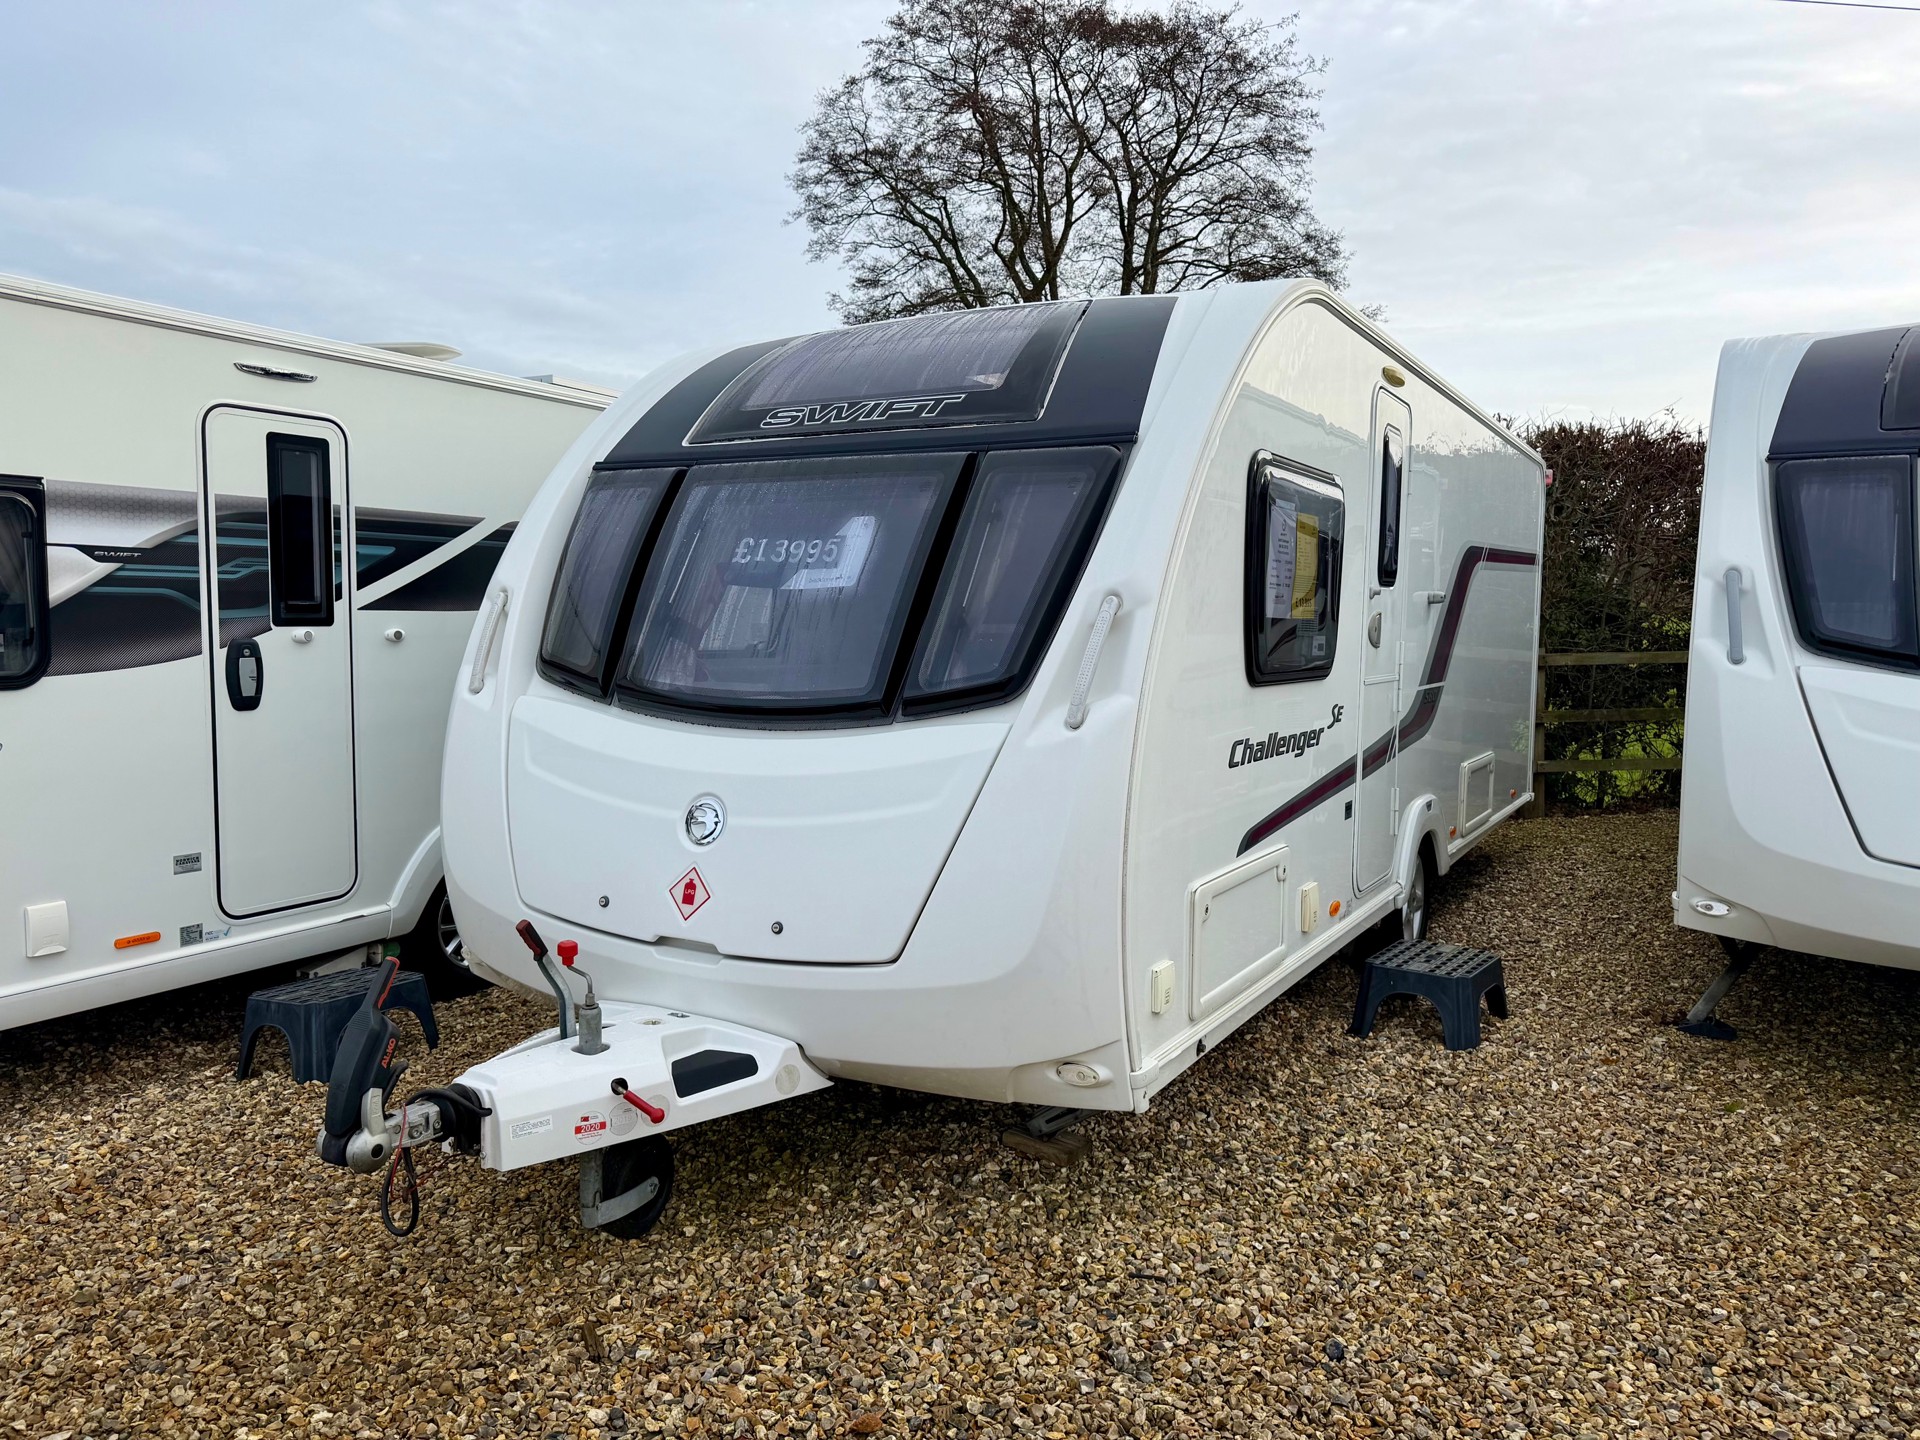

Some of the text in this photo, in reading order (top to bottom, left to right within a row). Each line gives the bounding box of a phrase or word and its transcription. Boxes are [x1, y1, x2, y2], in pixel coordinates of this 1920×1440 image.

[760, 393, 968, 428] SWIFT
[732, 537, 841, 563] £13995
[1228, 703, 1344, 769] Challenger SE
[580, 1122, 601, 1133] 2020
